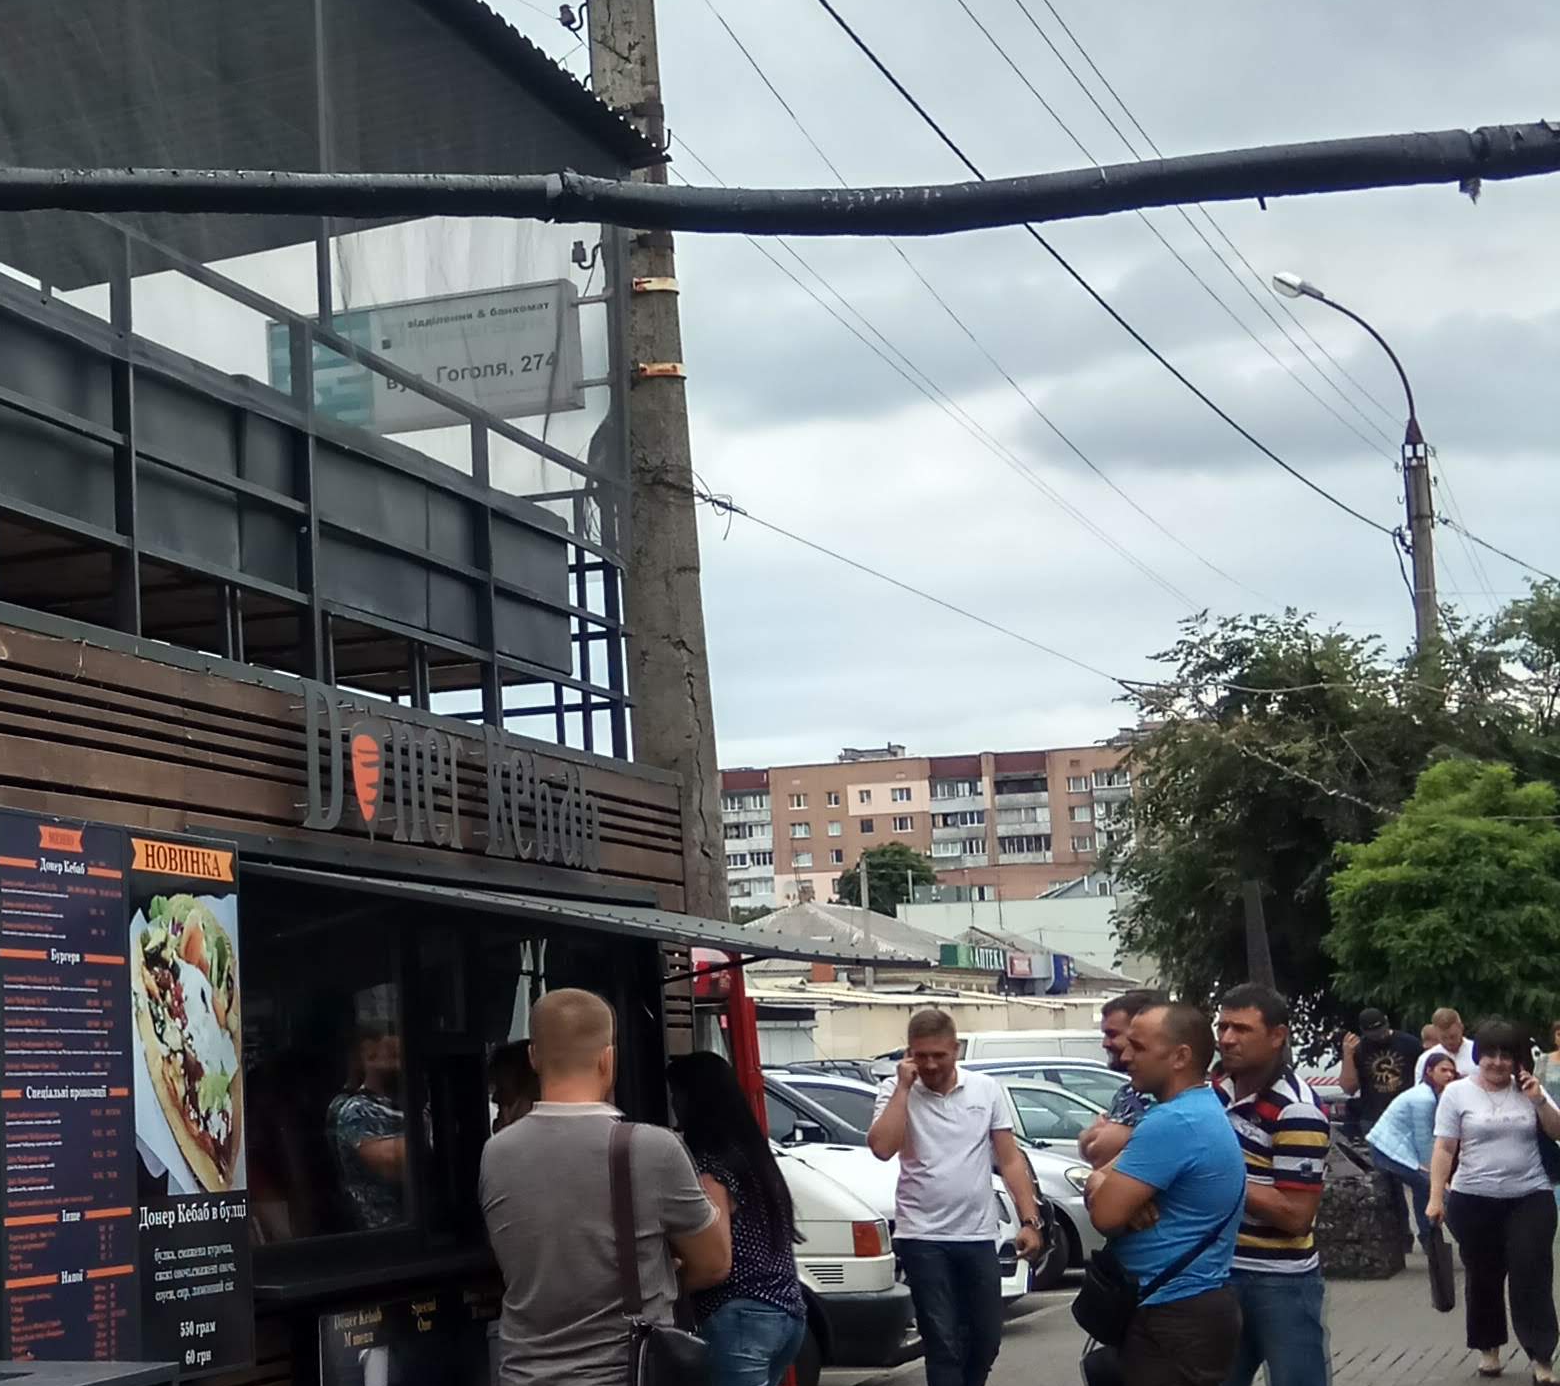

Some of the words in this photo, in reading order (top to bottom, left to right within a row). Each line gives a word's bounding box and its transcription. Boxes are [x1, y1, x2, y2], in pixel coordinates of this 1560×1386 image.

[477, 309, 486, 318] &
[490, 302, 549, 317] банкомат
[436, 362, 514, 383] Гоголя,
[144, 843, 221, 878] НОВИНКА
[974, 947, 1005, 971] АПТЕКА
[139, 1206, 176, 1231] Донер
[177, 1200, 210, 1223] Кебаб
[212, 1205, 218, 1220] в
[219, 1199, 247, 1223] булці
[196, 1320, 216, 1338] грам
[185, 1349, 195, 1365] 60
[196, 1349, 212, 1366] грн
